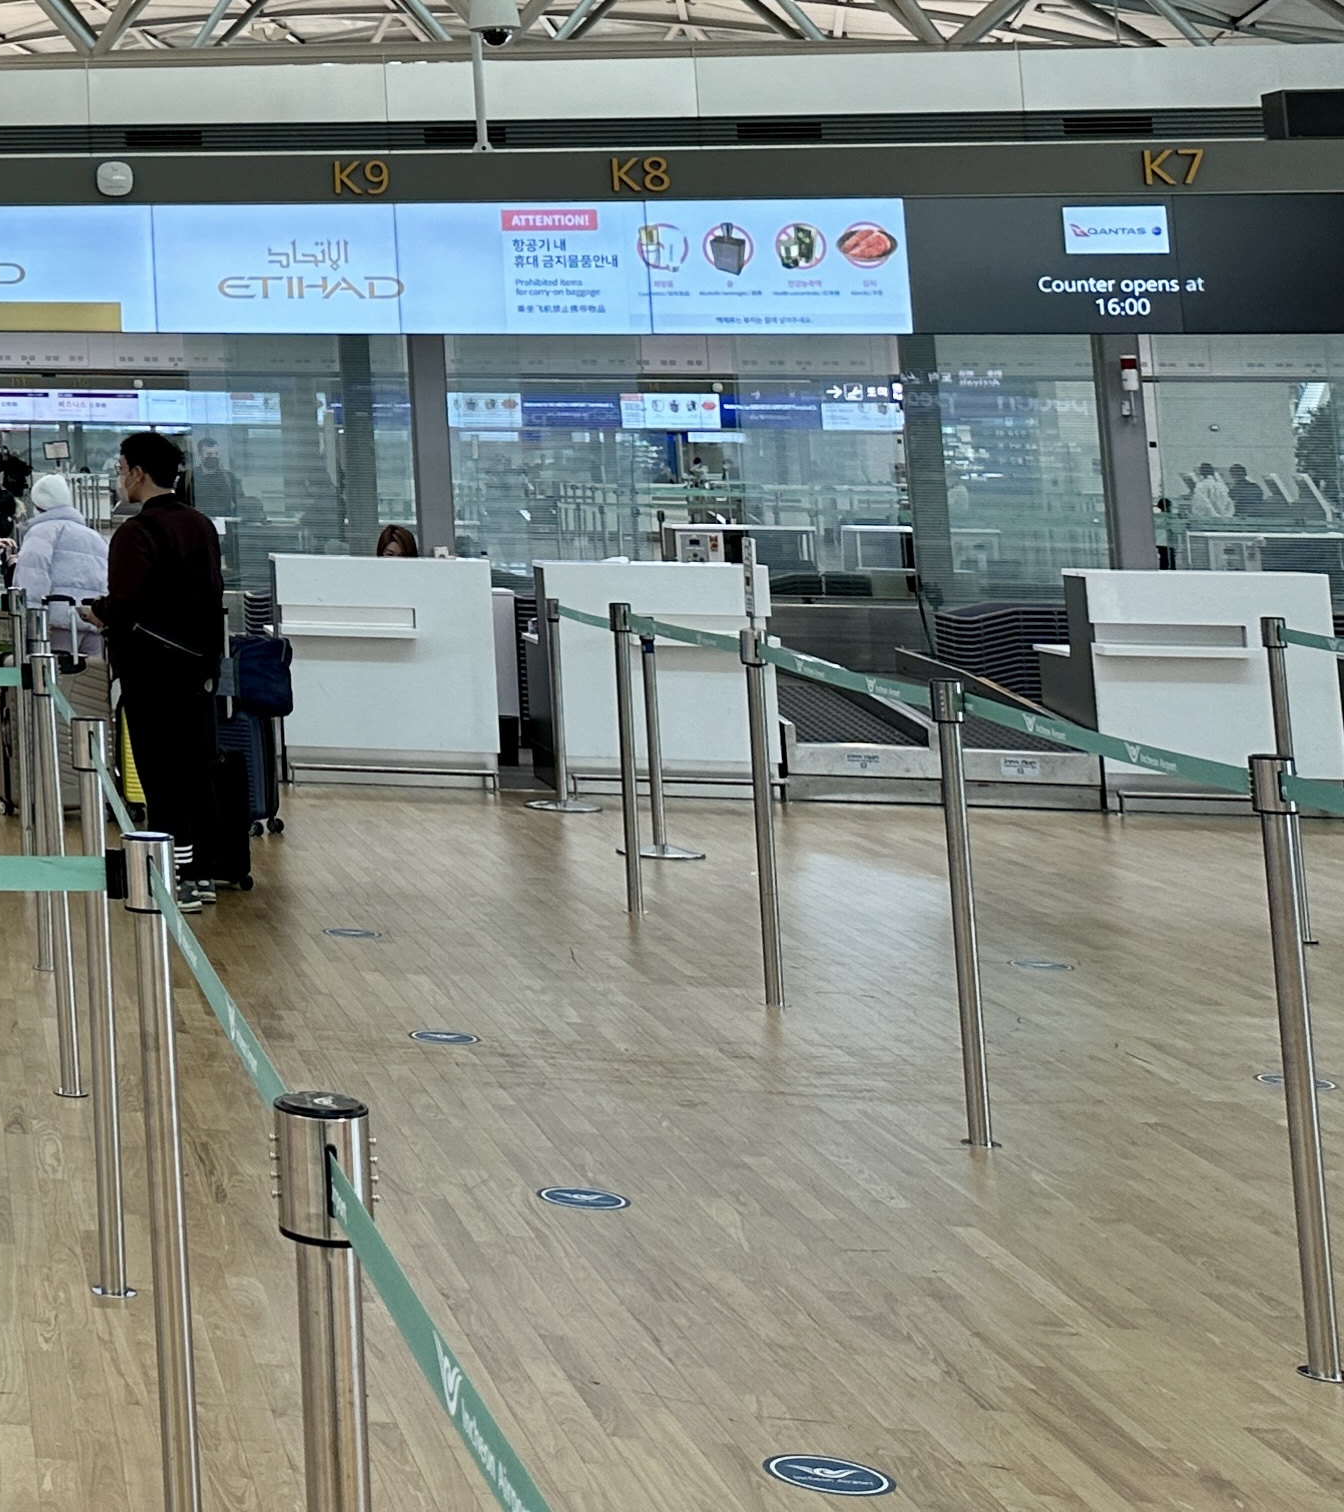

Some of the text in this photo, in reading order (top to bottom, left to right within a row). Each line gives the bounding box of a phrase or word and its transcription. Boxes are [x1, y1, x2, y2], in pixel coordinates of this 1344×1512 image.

[612, 157, 670, 191] K8
[1144, 149, 1203, 184] K7
[334, 160, 388, 194] K9
[512, 215, 589, 226] ATTENTION!
[1087, 227, 1146, 235] QANTAS
[512, 239, 566, 252] 항공기 내
[514, 255, 539, 268] 휴대
[218, 277, 405, 299] ETIHAD
[1039, 277, 1204, 296] Counter opens at
[1096, 298, 1150, 315] 16:00
